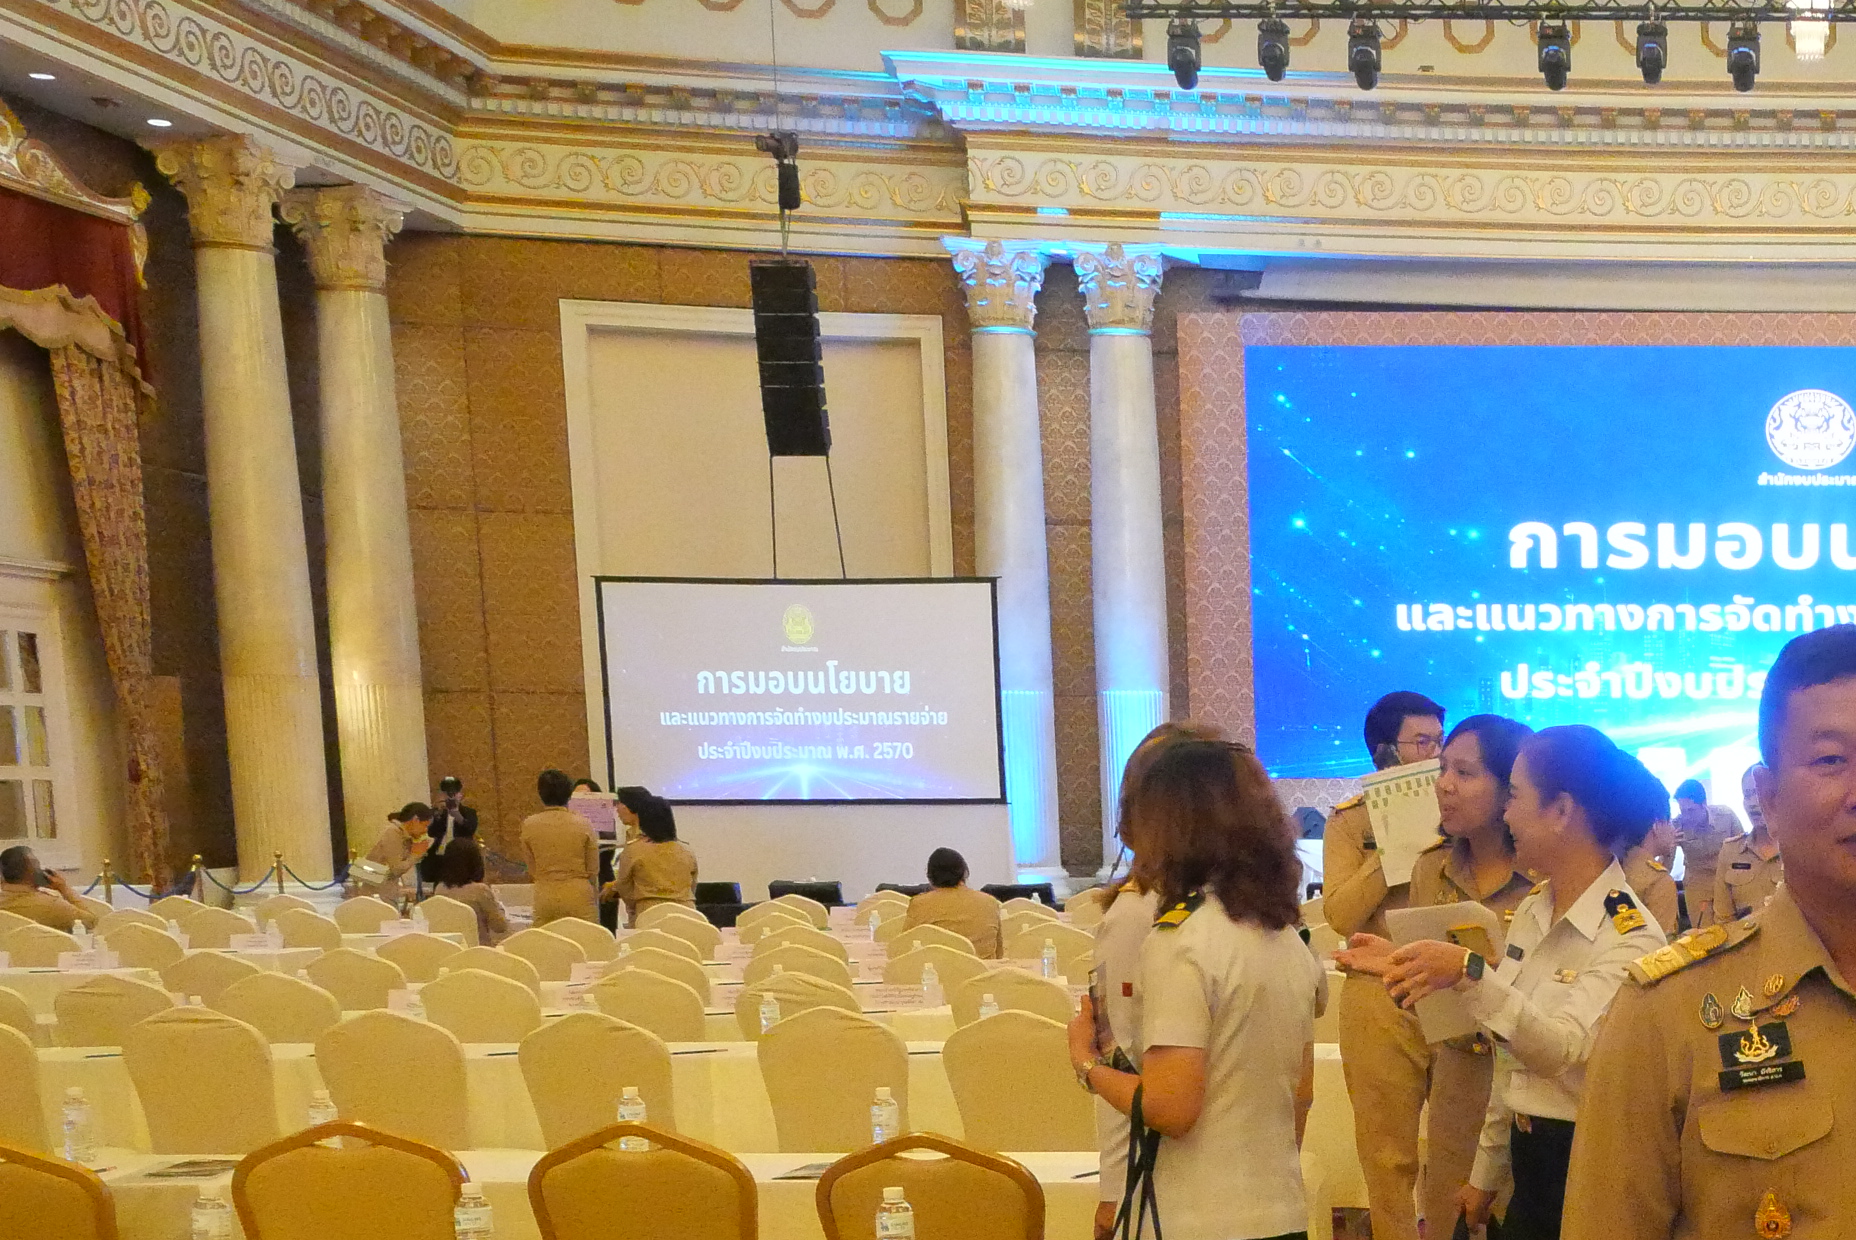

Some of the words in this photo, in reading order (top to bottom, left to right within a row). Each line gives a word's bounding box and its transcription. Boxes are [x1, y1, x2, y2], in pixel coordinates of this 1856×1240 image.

[696, 660, 911, 696] การมอบนโยบาย
[660, 706, 948, 726] และแนวทางการจัดทำงบประมาณรายจ่าย
[698, 741, 832, 760] ประจำปีงบประมาณ
[836, 744, 870, 760] พ.ศ.
[873, 742, 914, 760] 2570
